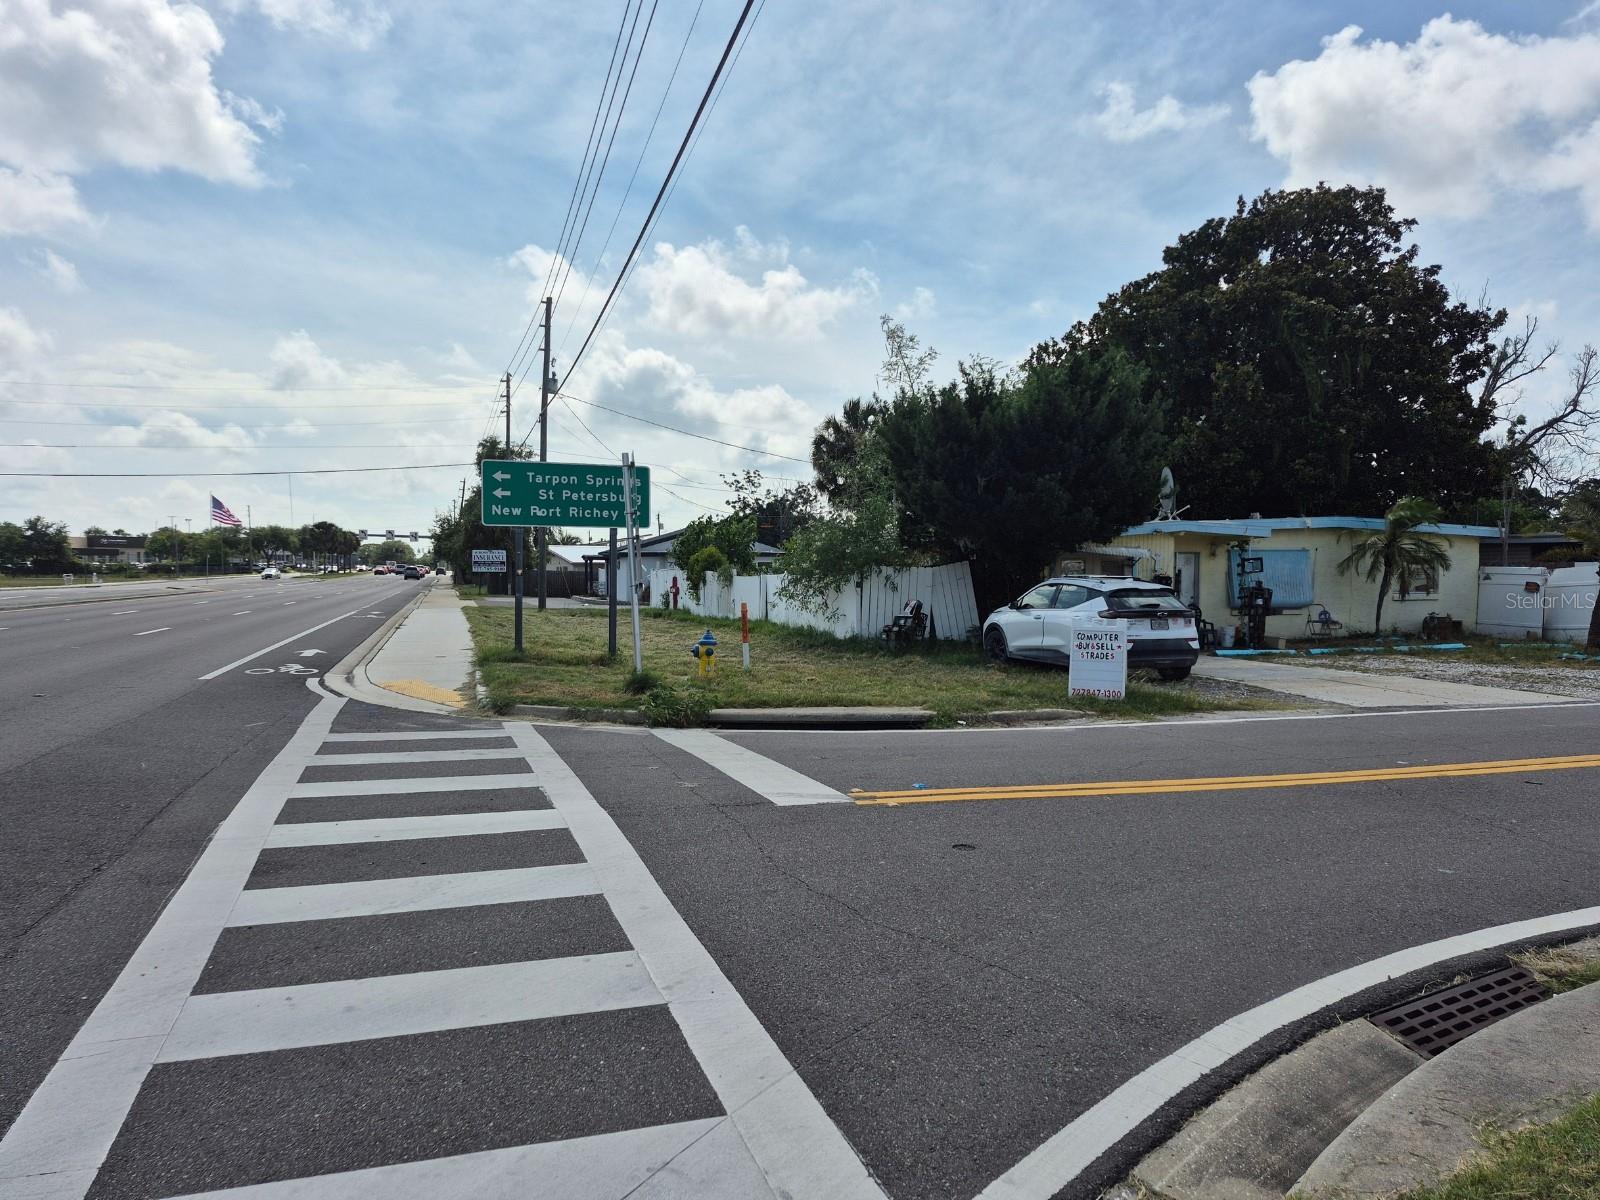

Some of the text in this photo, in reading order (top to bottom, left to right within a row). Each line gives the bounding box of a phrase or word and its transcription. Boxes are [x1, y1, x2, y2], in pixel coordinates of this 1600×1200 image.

[526, 472, 642, 488] Tarpon Sprins
[538, 489, 642, 505] St Petersbug
[492, 505, 618, 521] New Port Richey
[1076, 632, 1119, 642] COMPUTER
